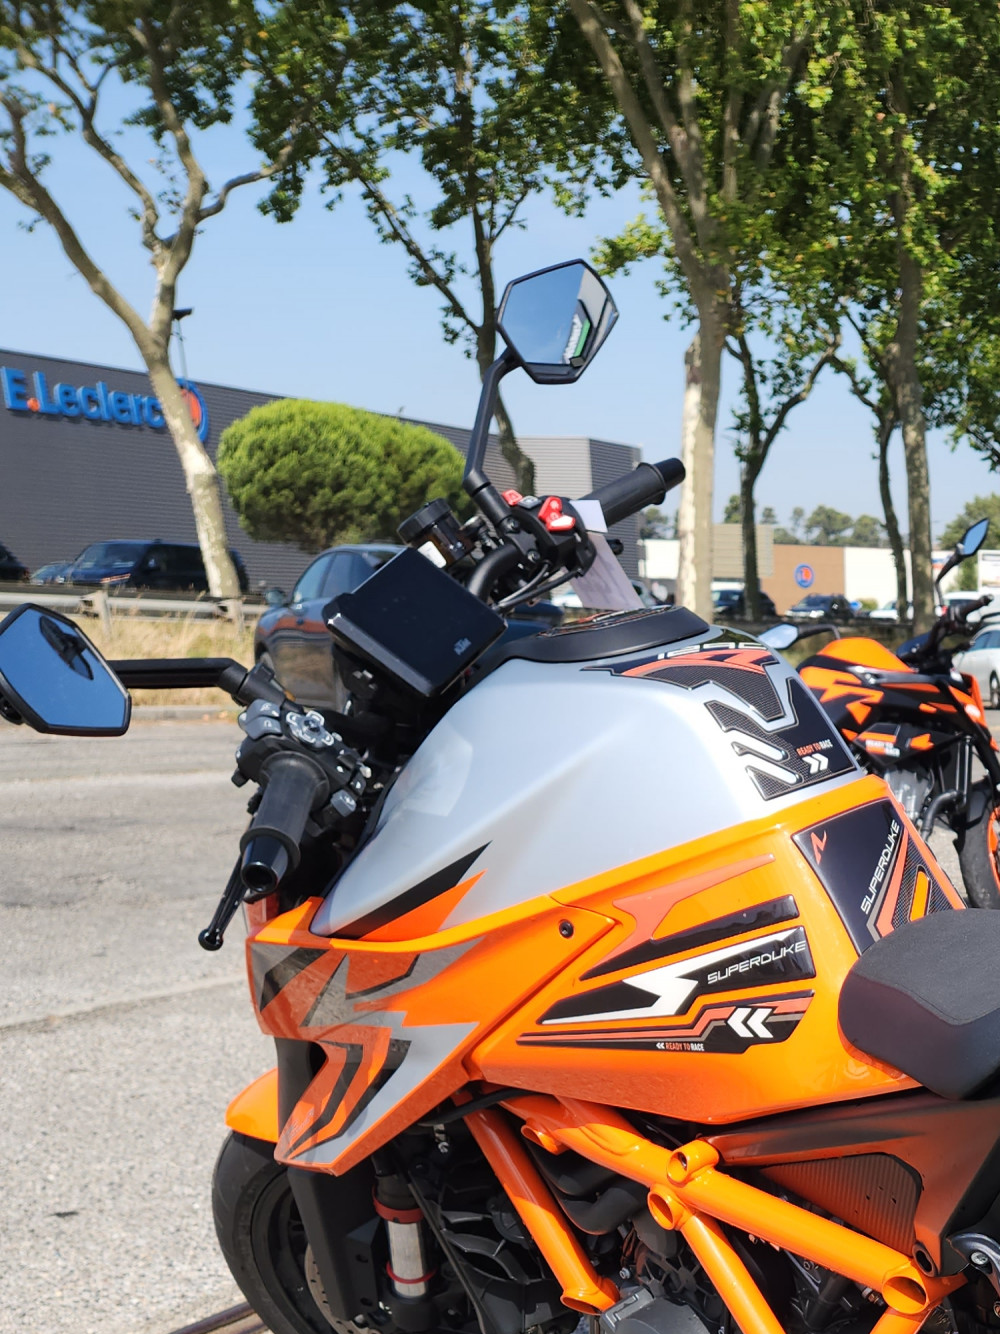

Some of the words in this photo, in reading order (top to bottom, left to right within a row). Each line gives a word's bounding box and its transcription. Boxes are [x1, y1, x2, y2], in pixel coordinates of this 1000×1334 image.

[1, 366, 167, 428] E.Leclerc
[796, 744, 815, 756] READY
[860, 819, 900, 915] SUPERDUKE
[707, 940, 806, 985] SUPERDUKE
[665, 1042, 683, 1051] READY
[690, 1042, 705, 1052] RACE
